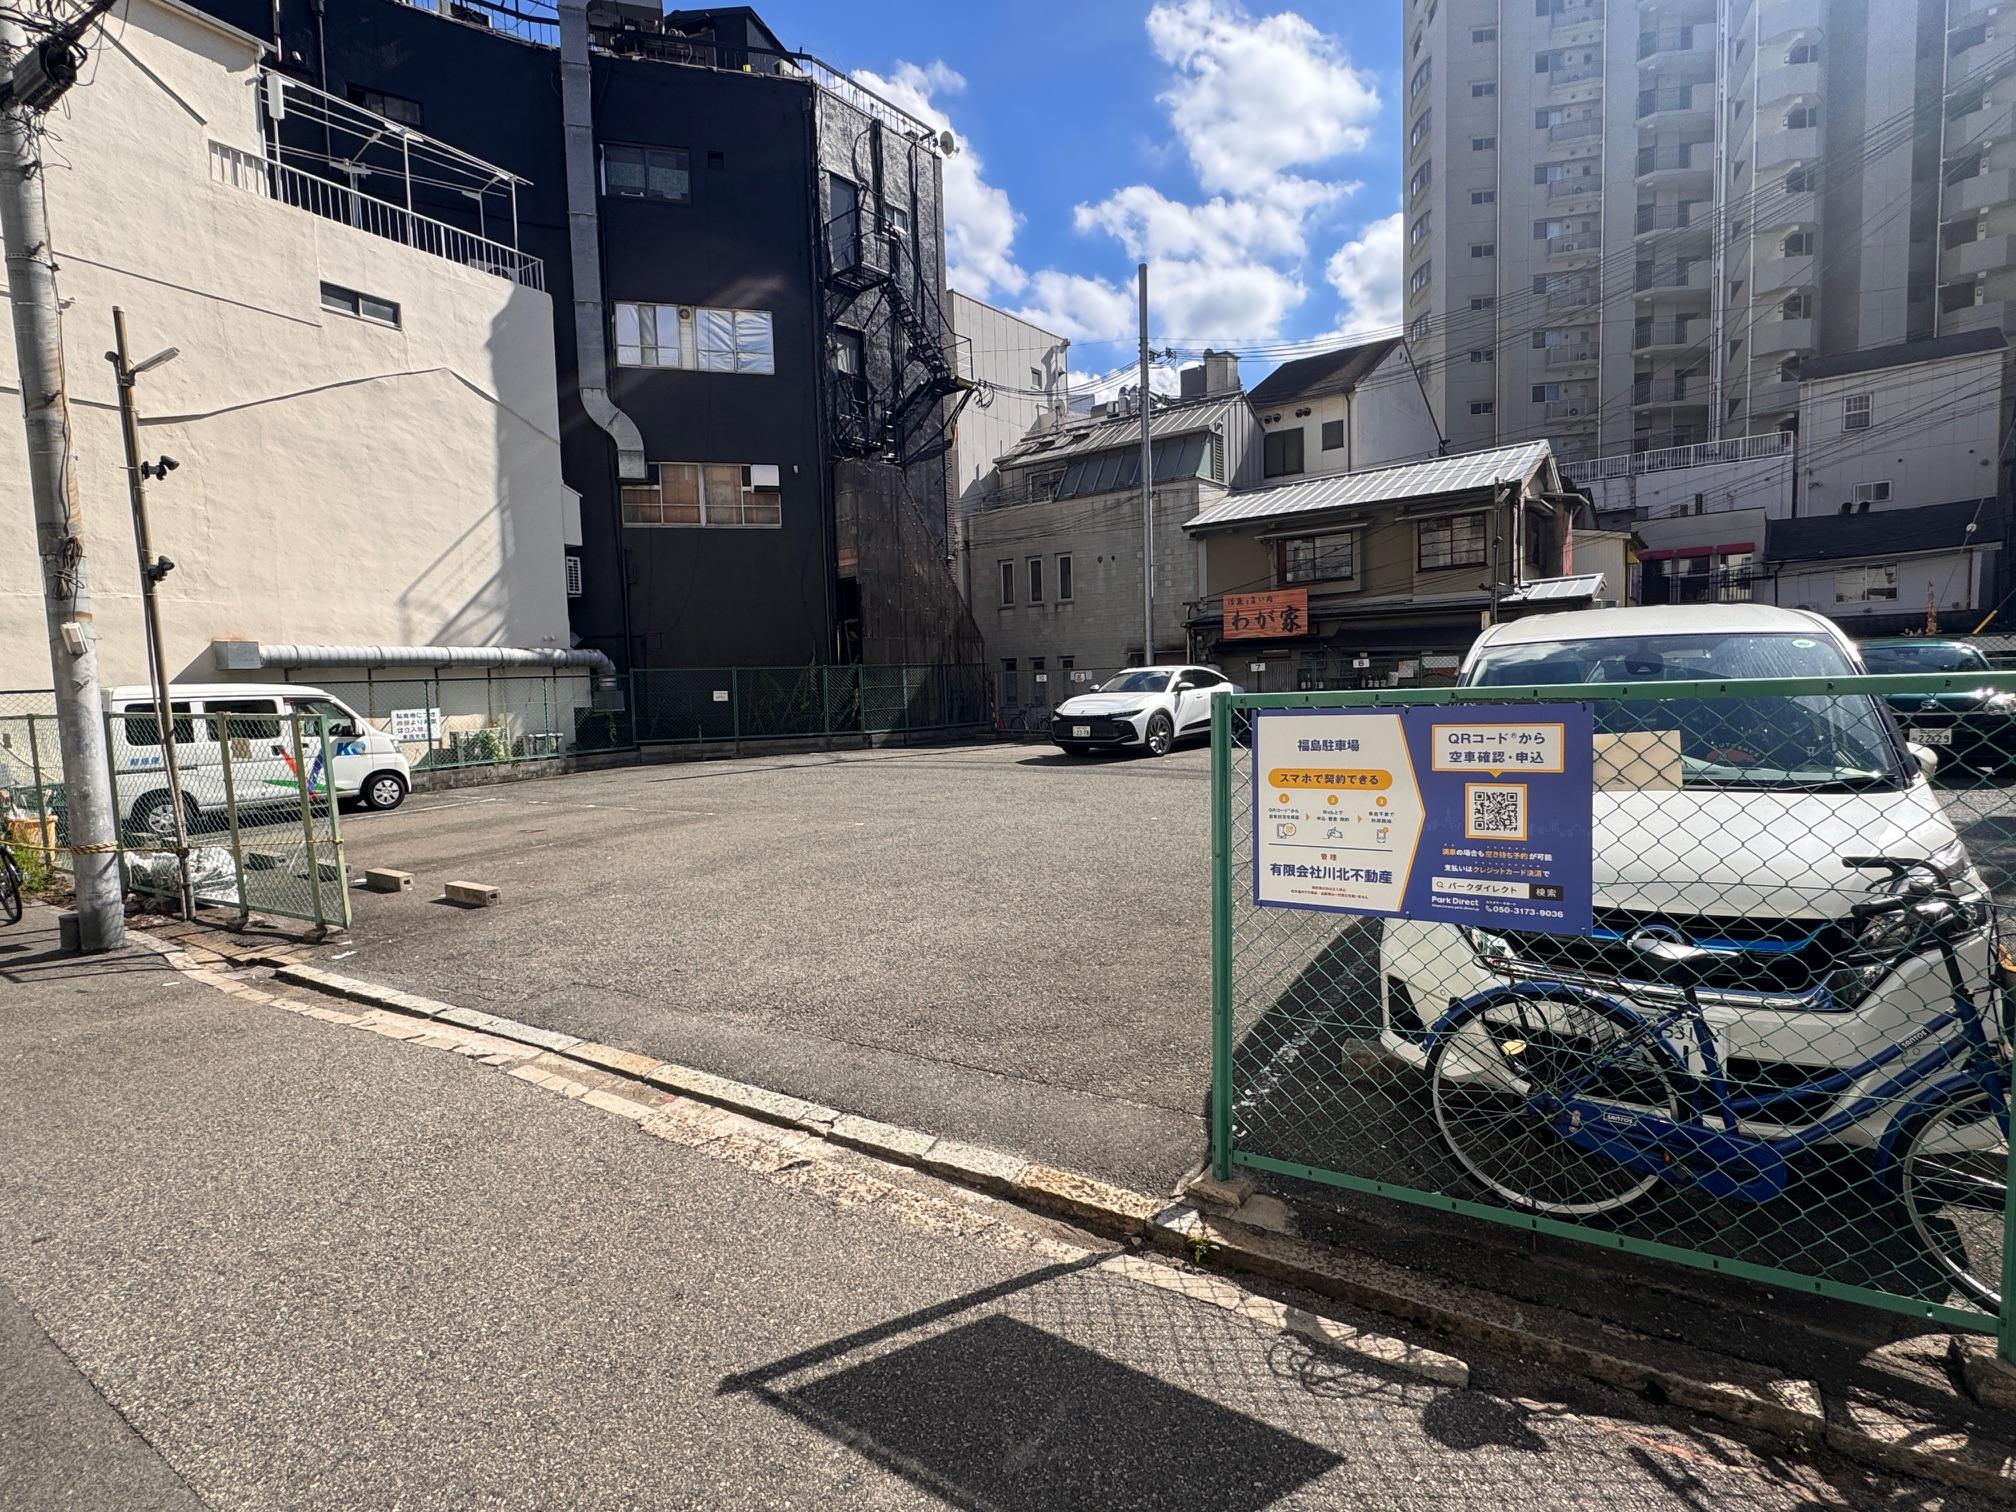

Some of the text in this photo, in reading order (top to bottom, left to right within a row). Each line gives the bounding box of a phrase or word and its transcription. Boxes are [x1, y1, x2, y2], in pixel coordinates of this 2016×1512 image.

[1231, 605, 1301, 633] わが家
[1297, 739, 1360, 752] 福島駐車場
[1449, 751, 1544, 764] 空車確認・申込
[1279, 773, 1379, 785] スマホで契約できる
[1320, 853, 1337, 861] 管理
[1269, 863, 1393, 884] 有限会社川北不動産
[1448, 882, 1557, 898] パークダイレクト 検索
[1432, 896, 1480, 906] Park Direct
[1492, 905, 1564, 919] 050-3173-9036
[1901, 1030, 1927, 1048] SANTOS
